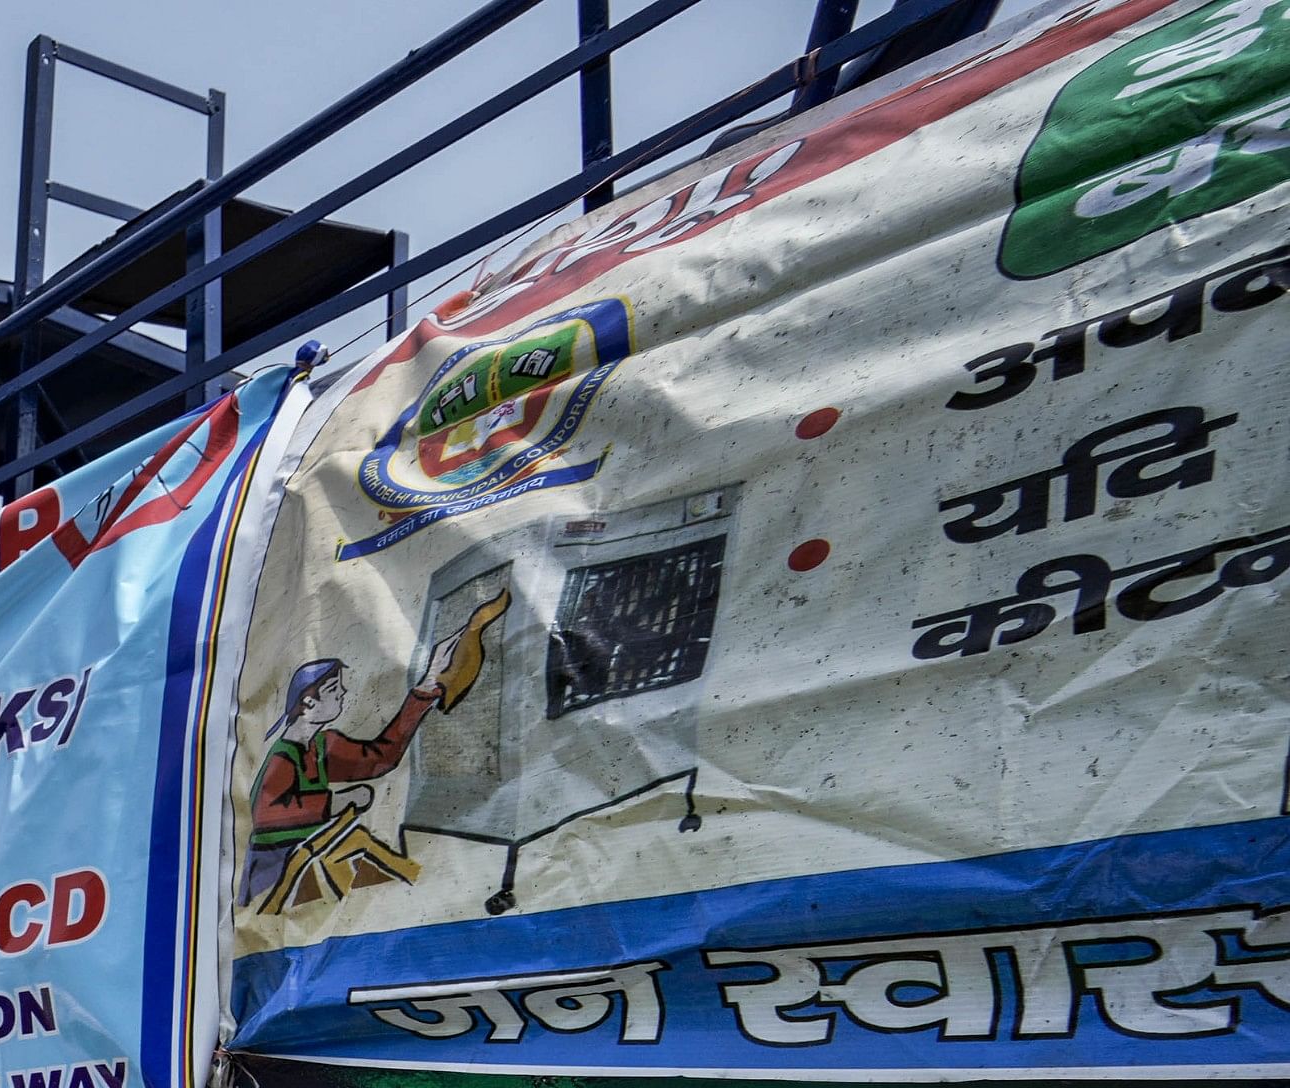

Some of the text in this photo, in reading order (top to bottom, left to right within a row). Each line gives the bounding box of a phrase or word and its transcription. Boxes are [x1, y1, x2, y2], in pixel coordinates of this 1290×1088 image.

[363, 362, 614, 504] NORTH DELHI MUNICIPAL CORPORATION
[938, 406, 1238, 543] यदि
[349, 960, 667, 1046] जन
